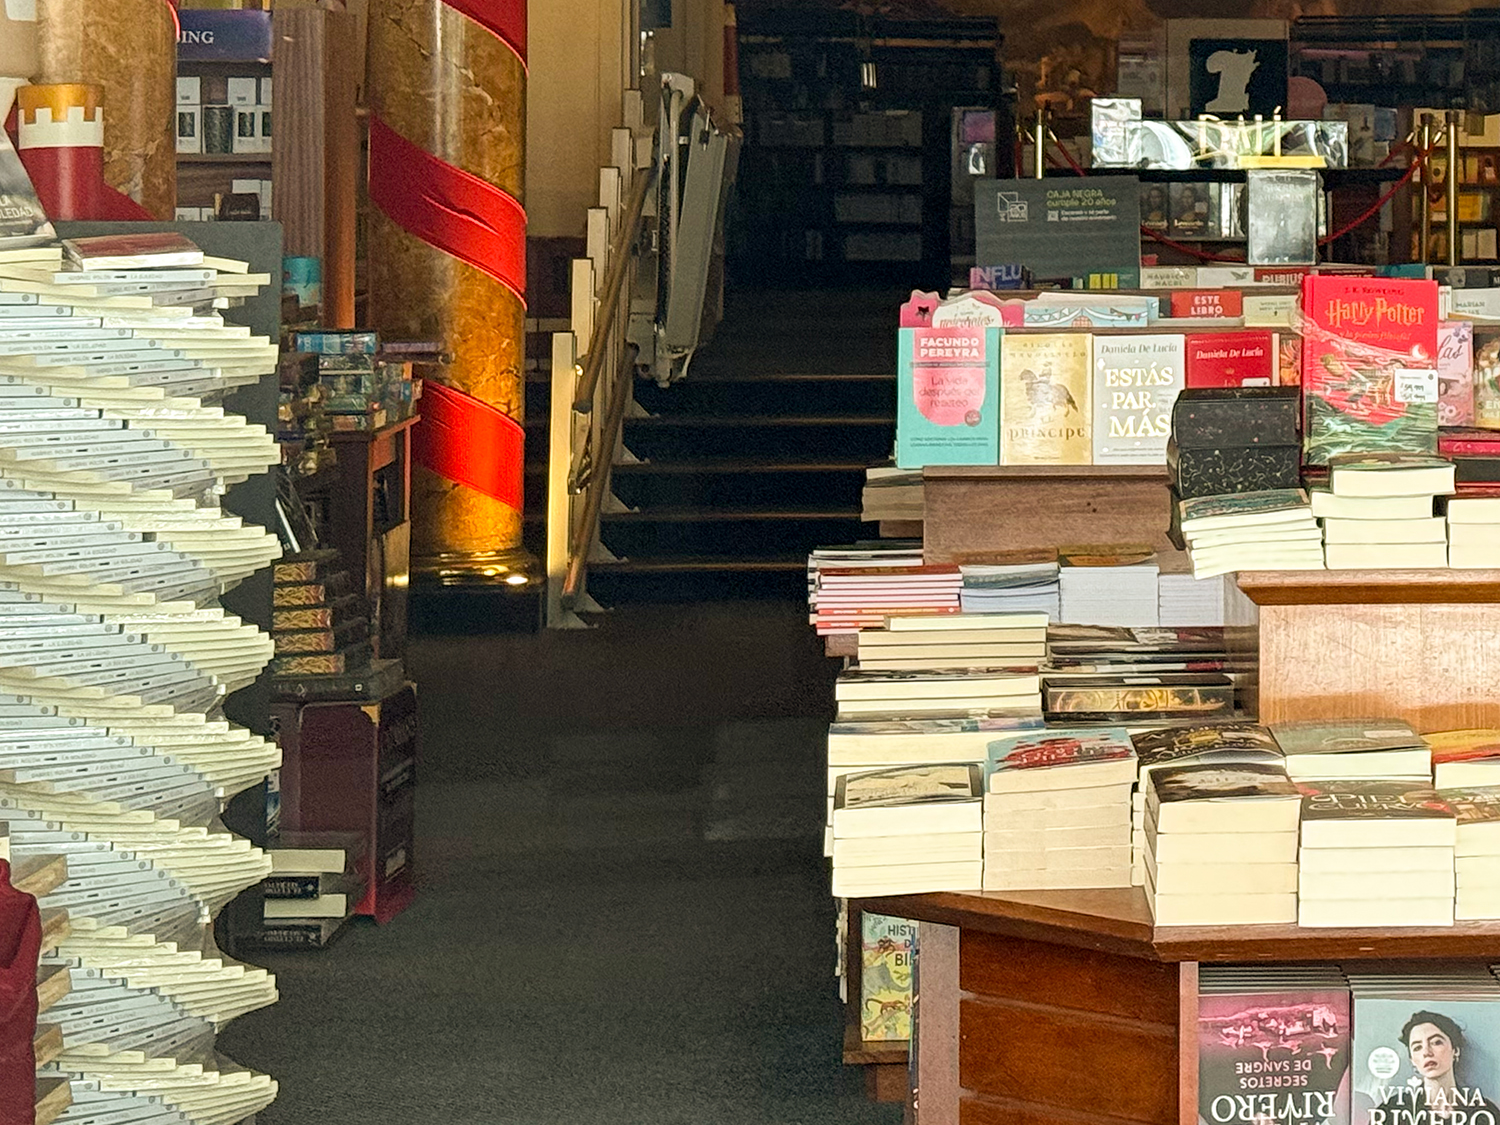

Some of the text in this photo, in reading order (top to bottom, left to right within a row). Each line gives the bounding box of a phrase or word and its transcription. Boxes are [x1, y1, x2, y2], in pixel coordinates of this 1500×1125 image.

[177, 30, 215, 45] ING
[1046, 188, 1103, 199] CAJA NEGRA
[1046, 197, 1117, 209] cumple 20 años
[1194, 295, 1221, 305] ESTE
[1455, 301, 1486, 309] MARIAN
[1190, 305, 1224, 316] LIBRO
[1325, 296, 1425, 328] Harry Potter
[920, 337, 980, 347] FACUNDO
[920, 348, 980, 358] PEREYRA
[1101, 343, 1178, 354] Daniela De Lucía
[1196, 349, 1228, 360] Daniela
[1228, 349, 1241, 359] De
[1104, 361, 1175, 387] ESTÁS
[1108, 411, 1171, 438] MÁS
[1235, 1059, 1312, 1074] DE SANGRE
[1240, 1074, 1308, 1089] SECRETOS
[1378, 1085, 1486, 1107] VIVIANA
[1210, 1090, 1337, 1123] RIVERO
